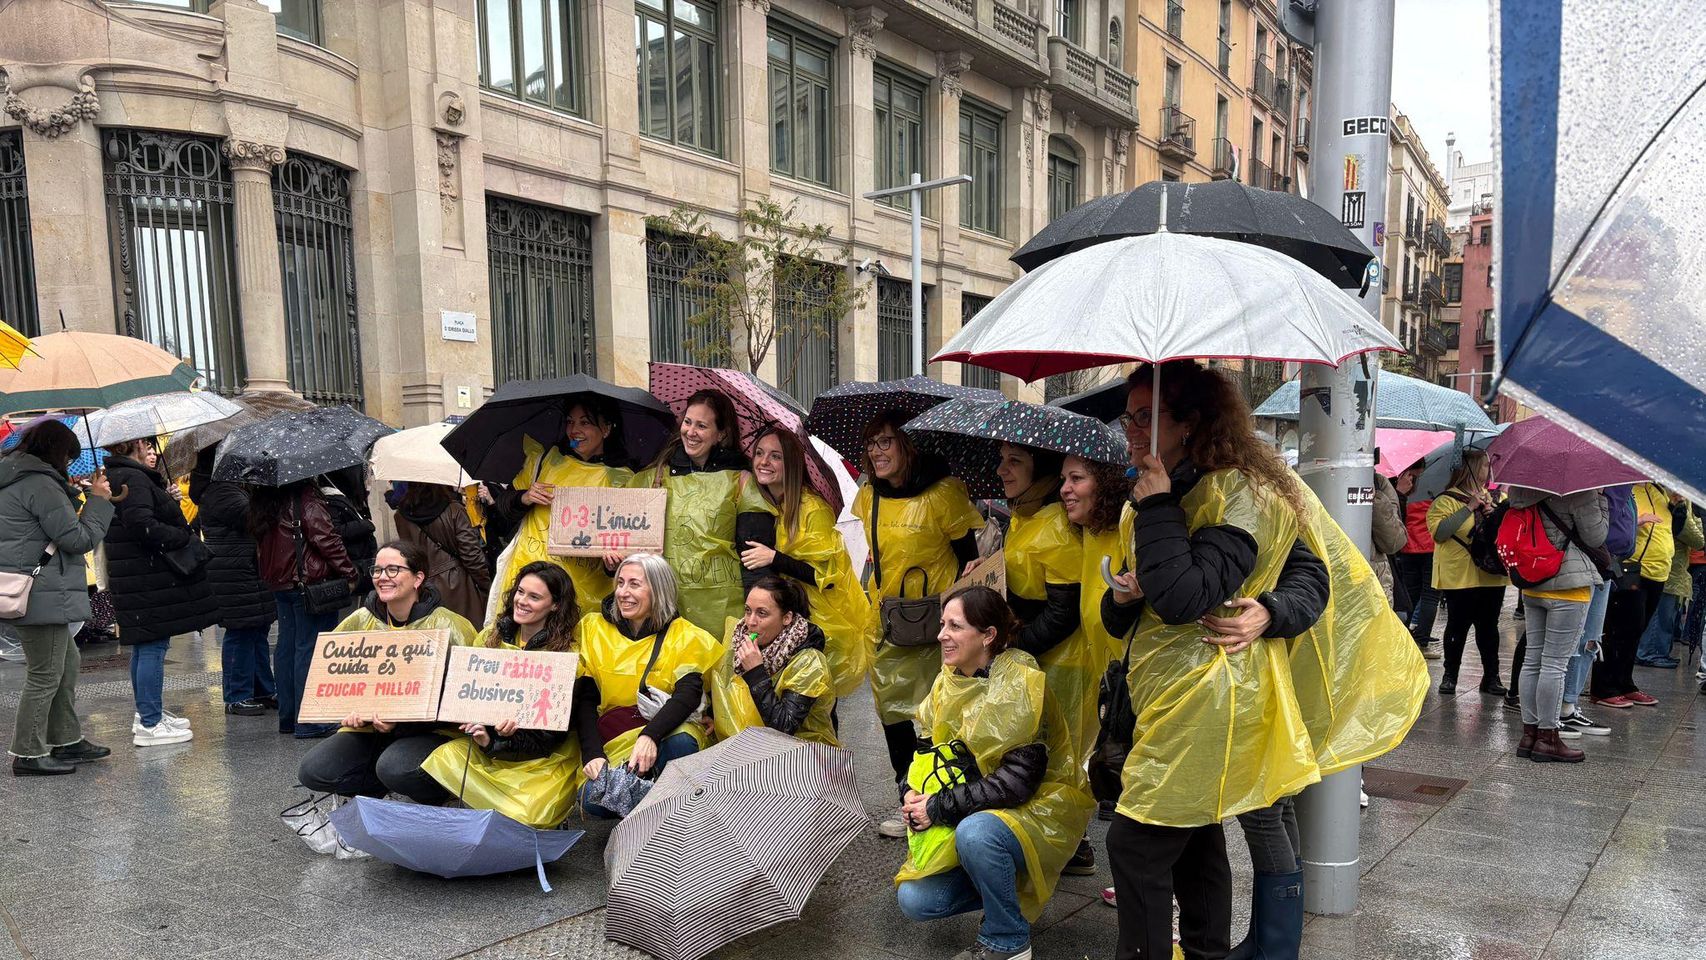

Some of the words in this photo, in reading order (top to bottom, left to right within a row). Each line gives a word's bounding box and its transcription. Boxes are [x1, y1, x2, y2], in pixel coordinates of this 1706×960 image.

[596, 504, 651, 531] L'inici
[571, 530, 592, 549] de
[598, 531, 631, 551] TOT
[322, 636, 383, 659] Cuidar
[385, 643, 399, 658] a
[402, 640, 434, 664] qui
[327, 659, 370, 675] cuida
[377, 658, 397, 676] és
[467, 654, 500, 675] Prou
[501, 656, 553, 683] ràtios
[315, 681, 367, 698] EDUCAR
[374, 680, 421, 696] MILLOR
[457, 679, 525, 704] abusives
